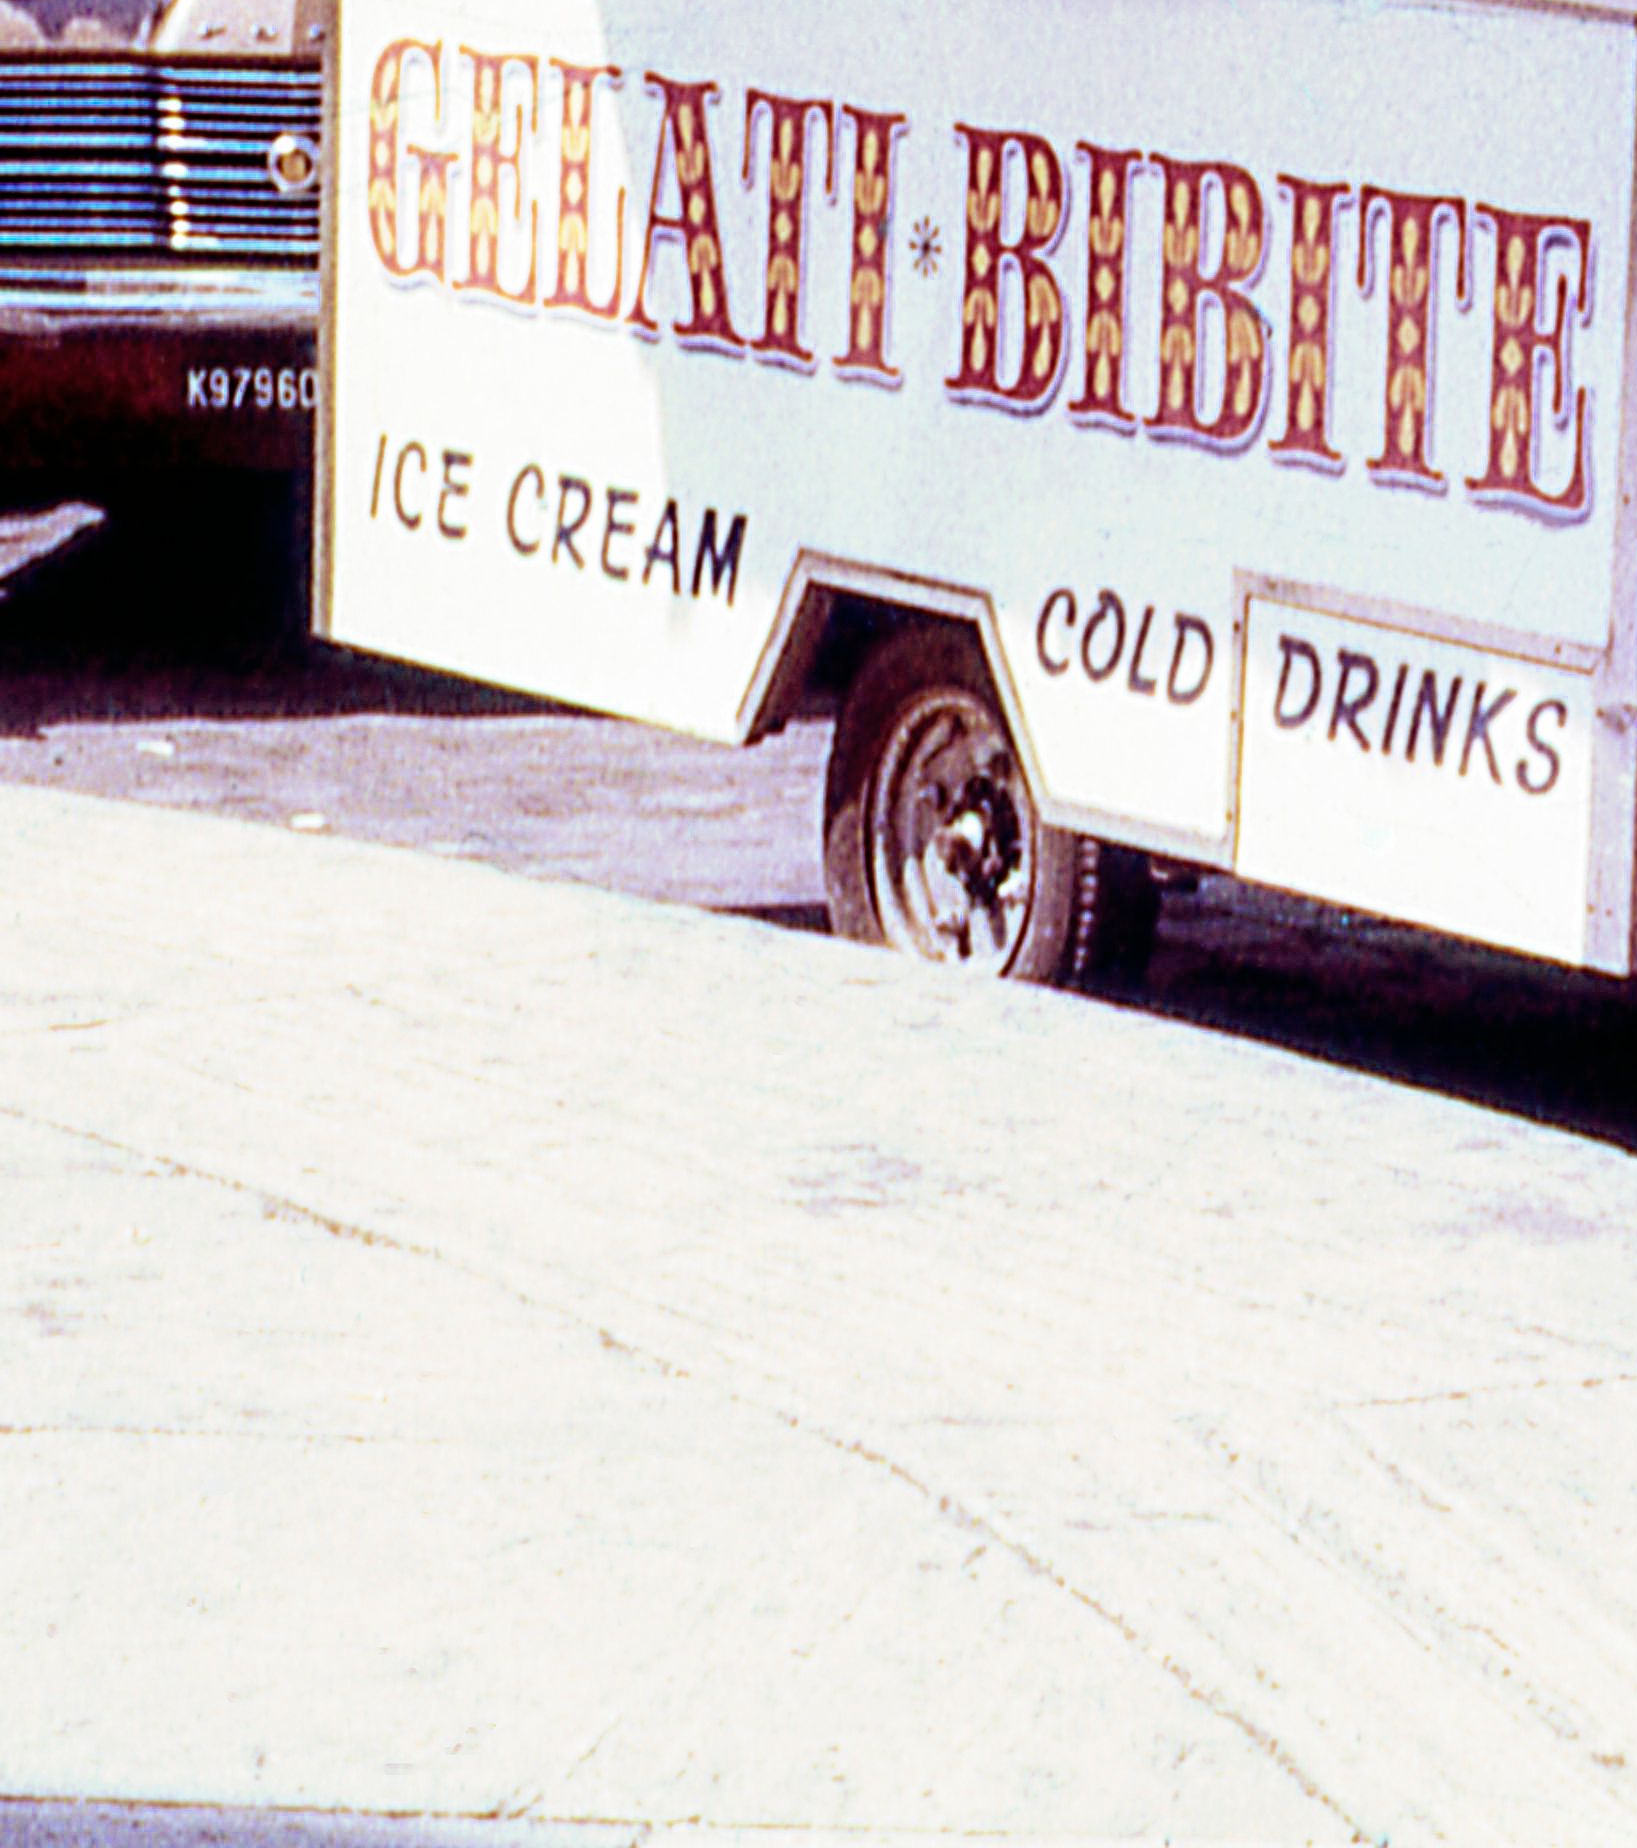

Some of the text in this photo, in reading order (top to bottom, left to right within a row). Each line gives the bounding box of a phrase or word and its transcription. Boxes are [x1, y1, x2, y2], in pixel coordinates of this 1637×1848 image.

[368, 36, 1593, 524] GELATI BIBITE
[370, 434, 748, 607] ICE CREAM
[1035, 587, 1567, 797] COLD DRINKS
